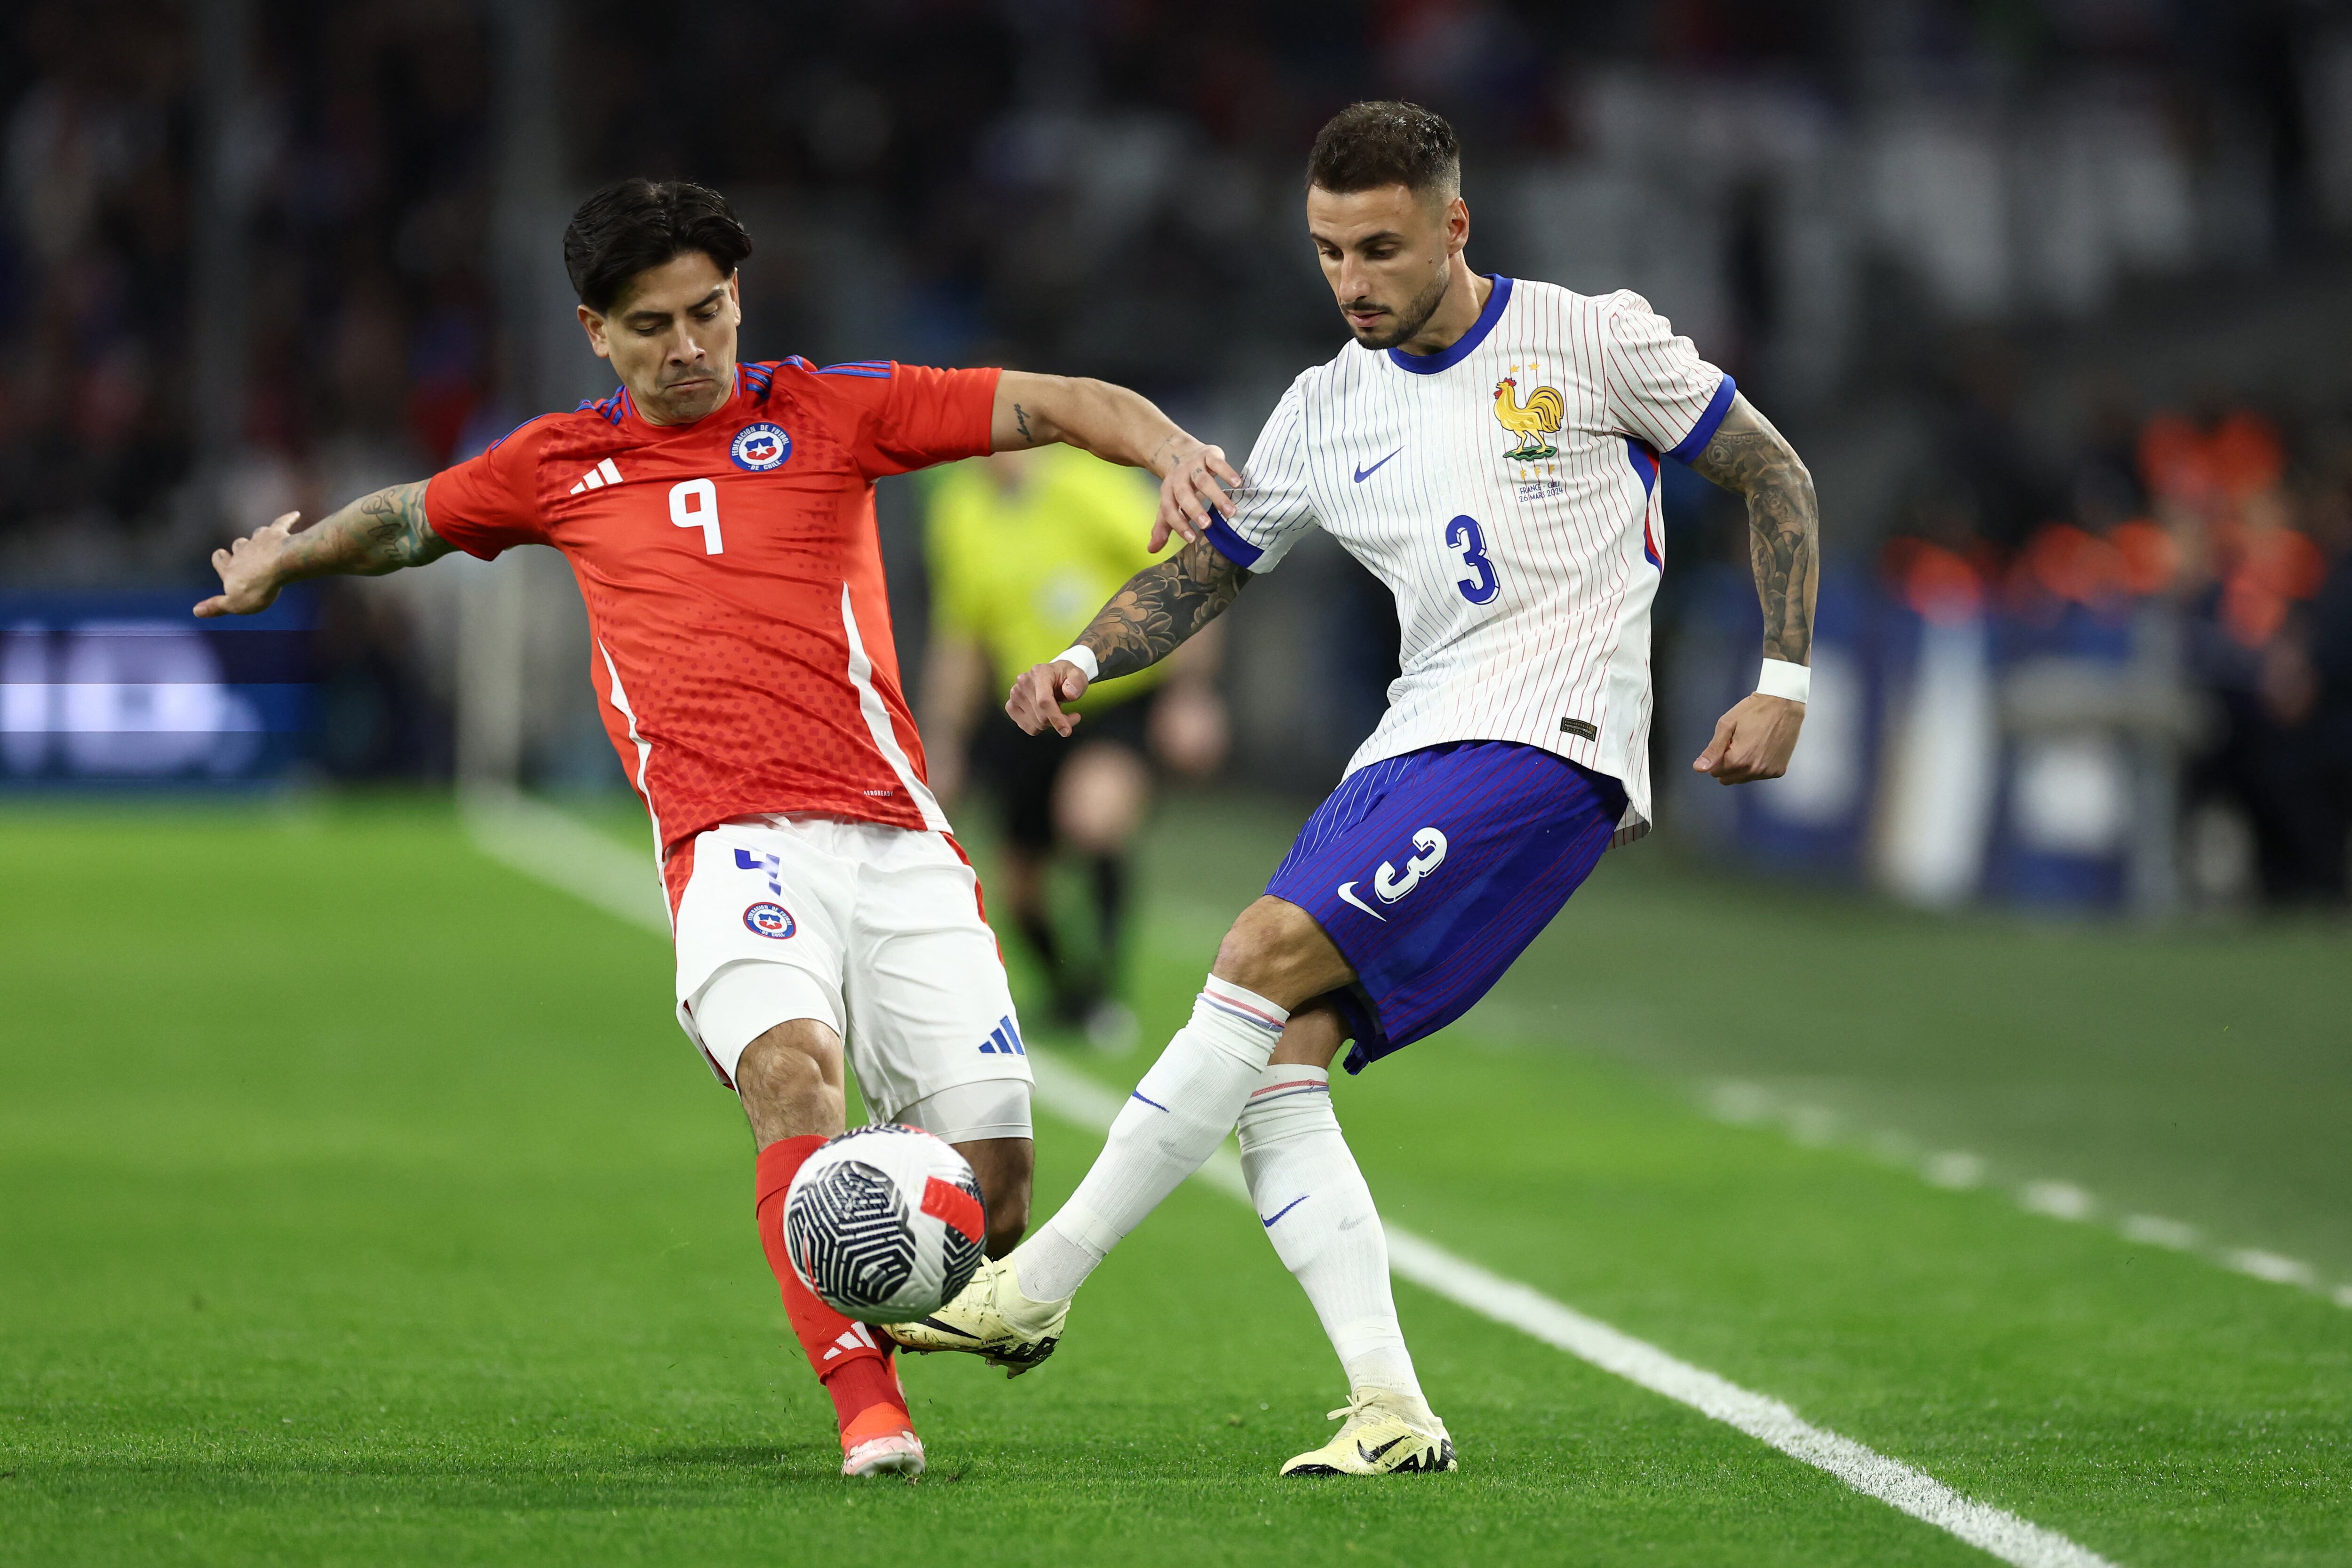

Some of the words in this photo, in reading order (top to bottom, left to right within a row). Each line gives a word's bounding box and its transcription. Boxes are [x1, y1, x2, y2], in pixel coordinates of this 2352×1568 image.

[732, 426, 756, 456] FEDERACION
[771, 427, 789, 445] FUTBOL
[763, 460, 780, 470] CHILE
[1520, 484, 1541, 494] FRANCE
[1530, 491, 1545, 500] MARS
[1547, 487, 1563, 496] 2024
[668, 478, 724, 555] 9
[1446, 515, 1500, 605] 3
[1375, 827, 1447, 904] 3
